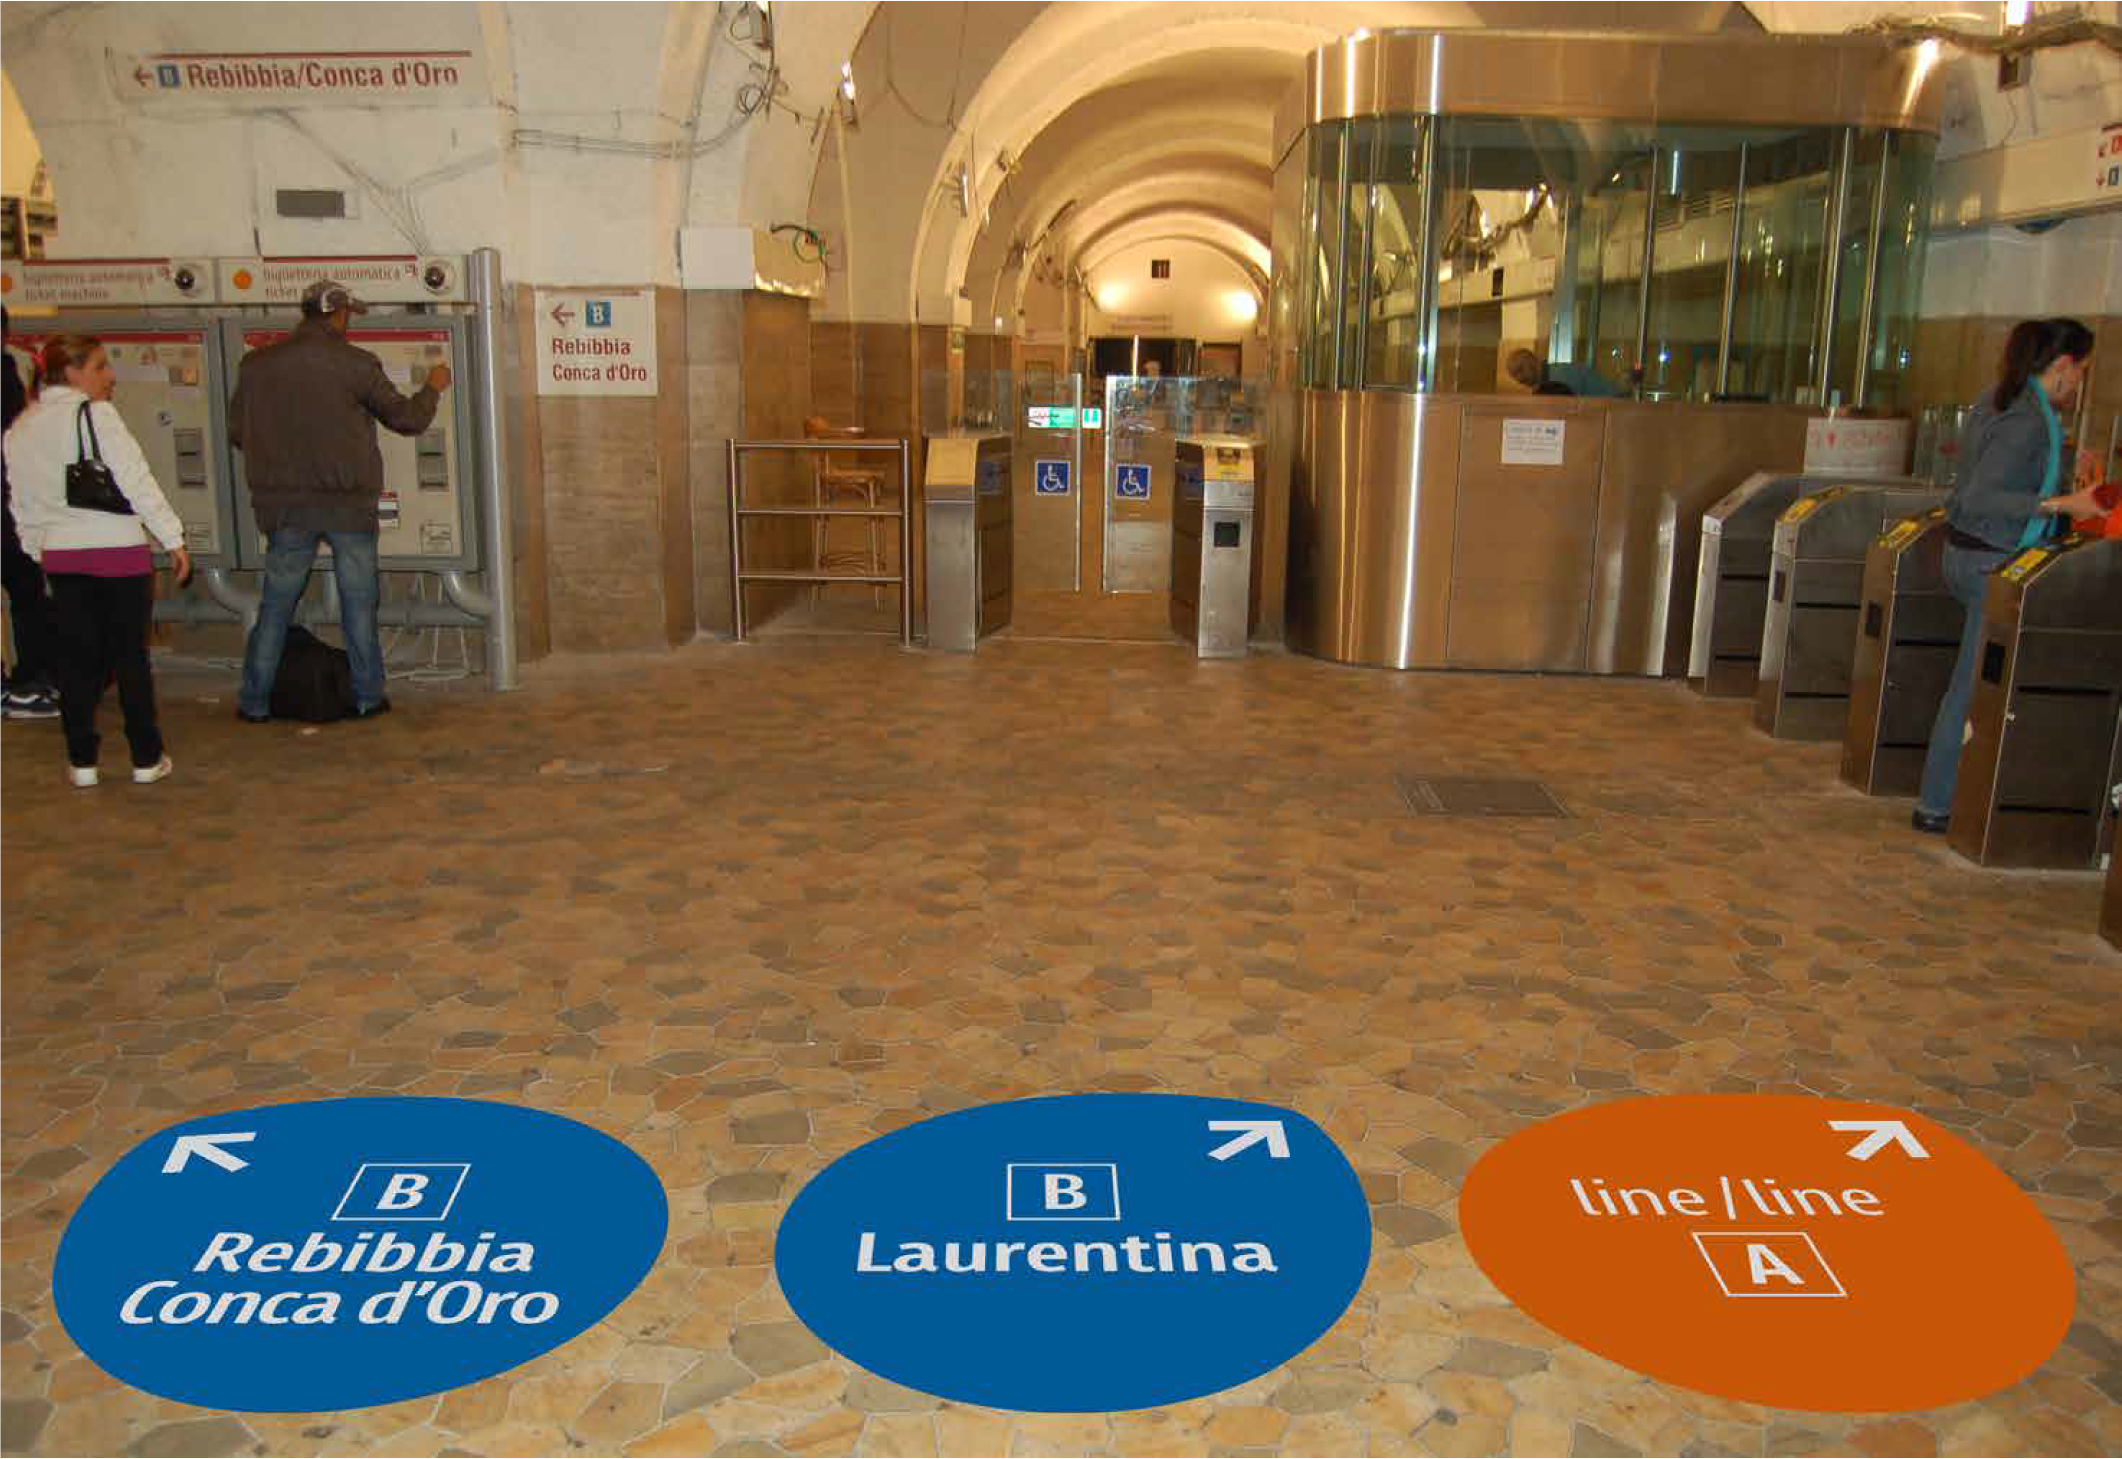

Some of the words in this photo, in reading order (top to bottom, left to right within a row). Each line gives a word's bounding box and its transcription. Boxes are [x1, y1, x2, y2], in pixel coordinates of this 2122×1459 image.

[391, 61, 459, 87] d'Oro
[592, 304, 605, 324] B
[552, 337, 632, 355] Rebibbia
[552, 363, 600, 381] Conca
[606, 363, 647, 381] d'Oro
[375, 1172, 430, 1211] B
[1043, 1172, 1088, 1211] B
[193, 1231, 536, 1273] Rebibbia
[856, 1231, 1280, 1273] Laurentina
[1746, 1243, 1806, 1285] A
[118, 1280, 341, 1325] Conca
[358, 1280, 560, 1325] d'Oro
